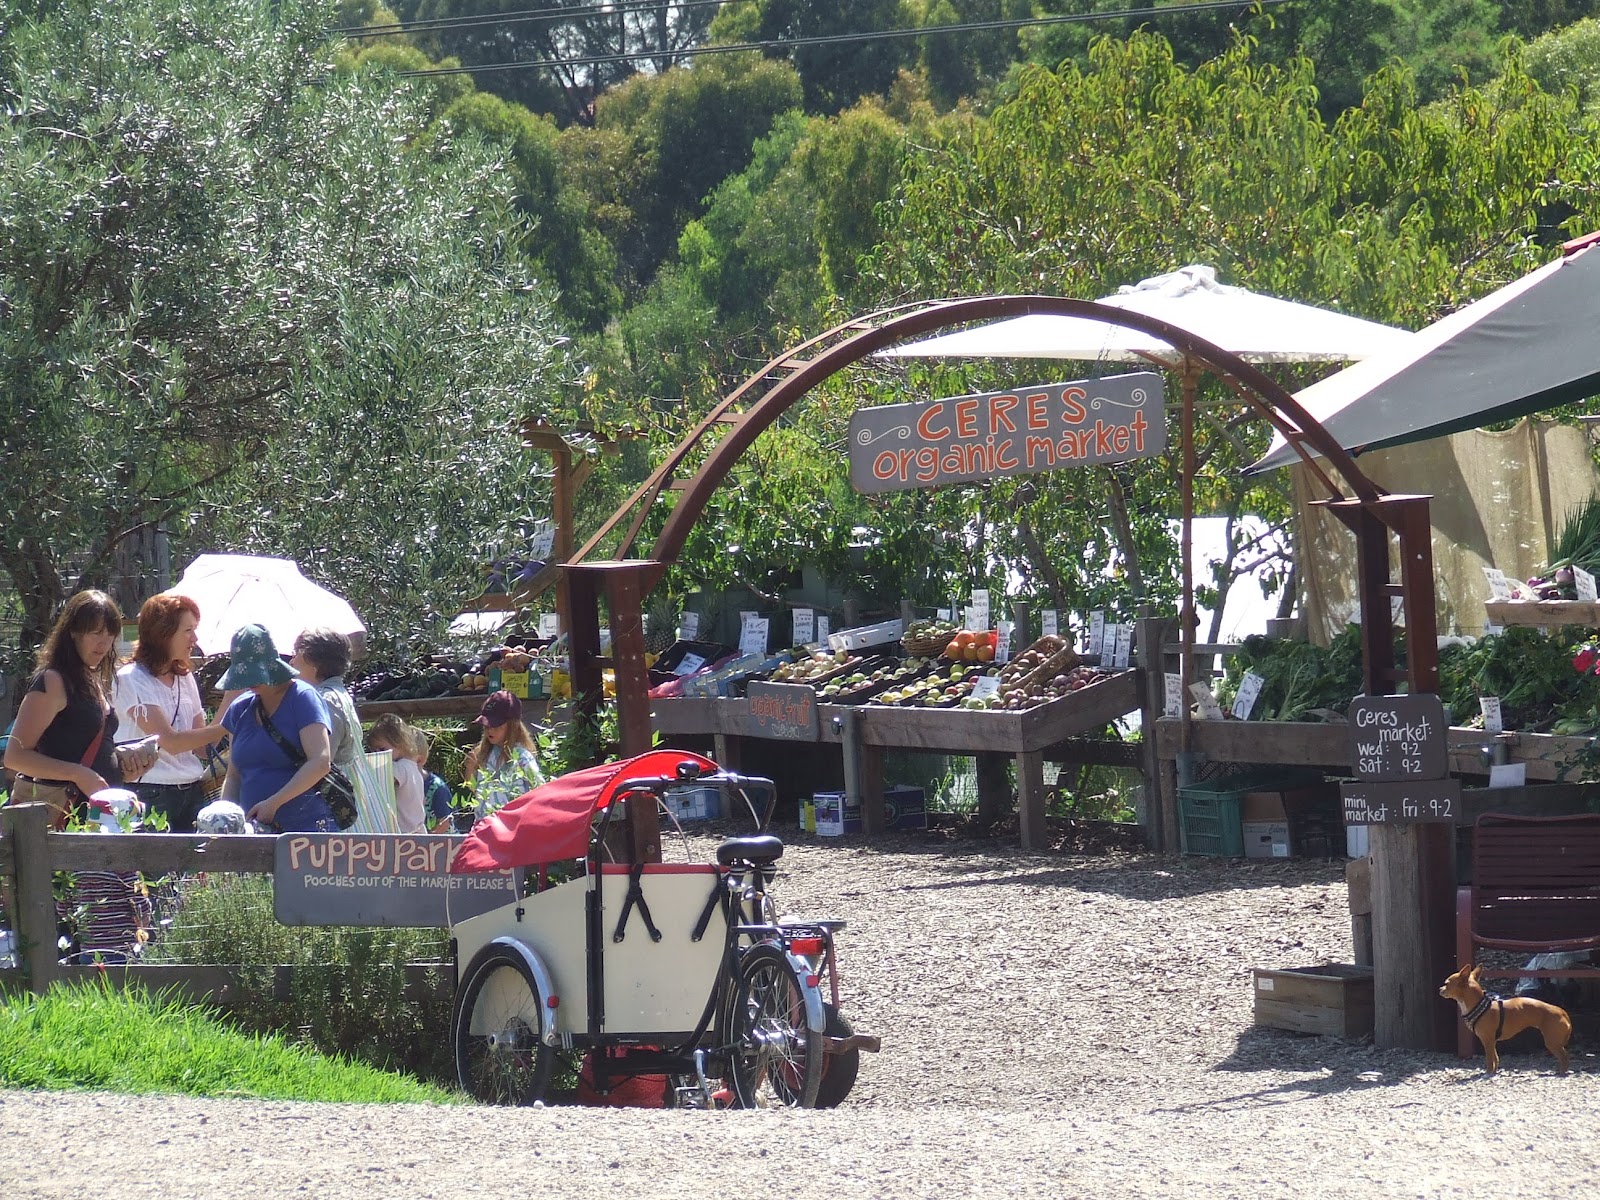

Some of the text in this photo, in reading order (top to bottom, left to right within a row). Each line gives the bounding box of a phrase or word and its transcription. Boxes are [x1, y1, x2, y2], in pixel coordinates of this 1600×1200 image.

[916, 386, 1087, 441] CERES
[872, 409, 1148, 482] organic market
[751, 693, 810, 727] organic fruit
[1356, 708, 1398, 728] Ceres
[1400, 741, 1421, 756] 9-2
[1401, 758, 1422, 773] 9-2
[1344, 794, 1366, 809] mini
[1429, 798, 1453, 817] 9-2
[288, 836, 386, 876] Puppy
[304, 874, 504, 890] POOCHES OUT OF THE MARKET PLEASE
